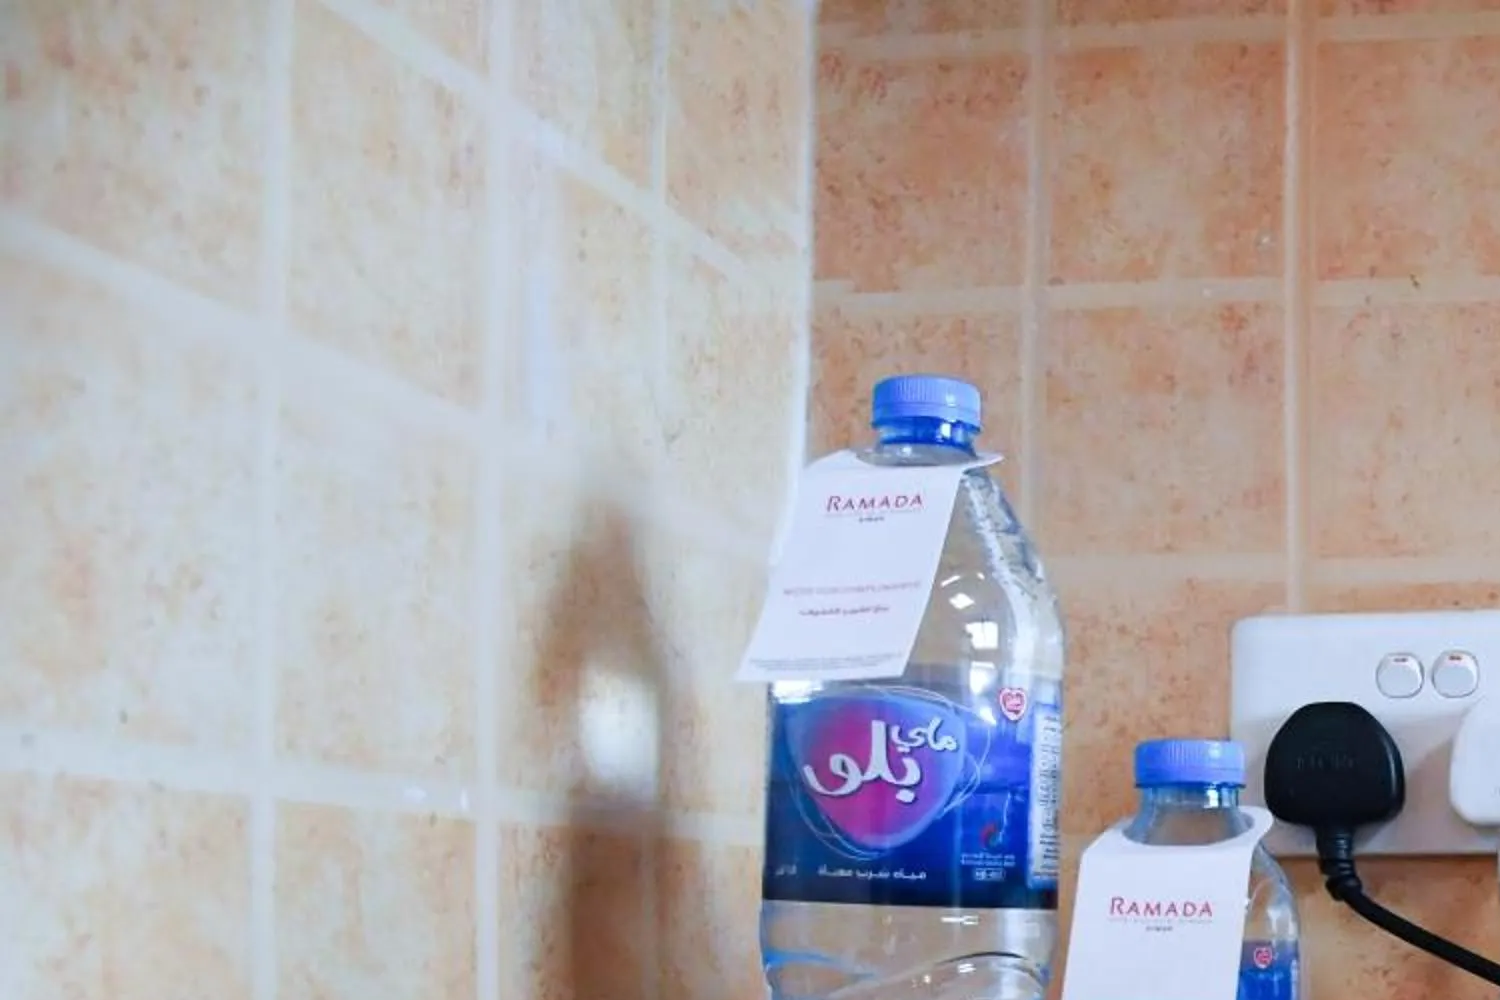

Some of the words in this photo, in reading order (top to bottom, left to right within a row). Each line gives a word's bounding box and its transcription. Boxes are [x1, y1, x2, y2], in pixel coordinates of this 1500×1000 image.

[826, 493, 923, 512] RAMADA
[890, 716, 958, 753] ماي
[803, 720, 921, 804] بلو
[1109, 896, 1213, 917] RAMADA
